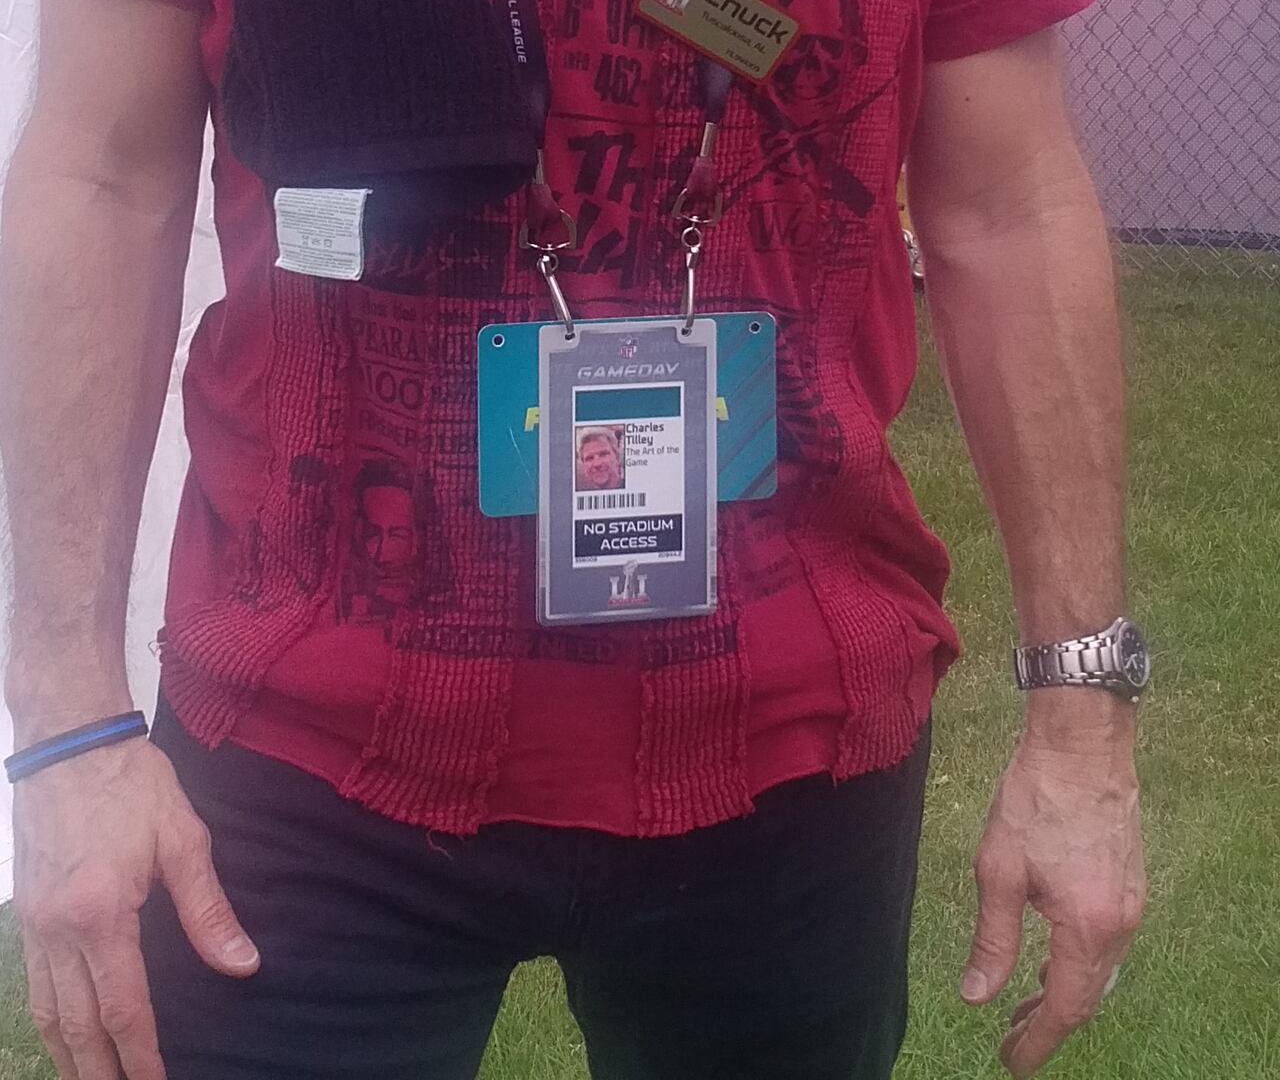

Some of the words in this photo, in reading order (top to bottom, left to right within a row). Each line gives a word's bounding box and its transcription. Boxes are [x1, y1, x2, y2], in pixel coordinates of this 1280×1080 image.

[510, 10, 527, 64] LEAGUE
[577, 361, 680, 380] GAMEDAY
[626, 422, 665, 433] Charles
[625, 435, 654, 446] Tilley
[626, 448, 641, 456] The
[642, 446, 655, 455] Art
[656, 445, 665, 454] of
[666, 445, 680, 453] the
[626, 458, 649, 466] Game
[583, 522, 606, 535] NO
[608, 518, 674, 534] STADIUM
[600, 535, 658, 550] ACCESS
